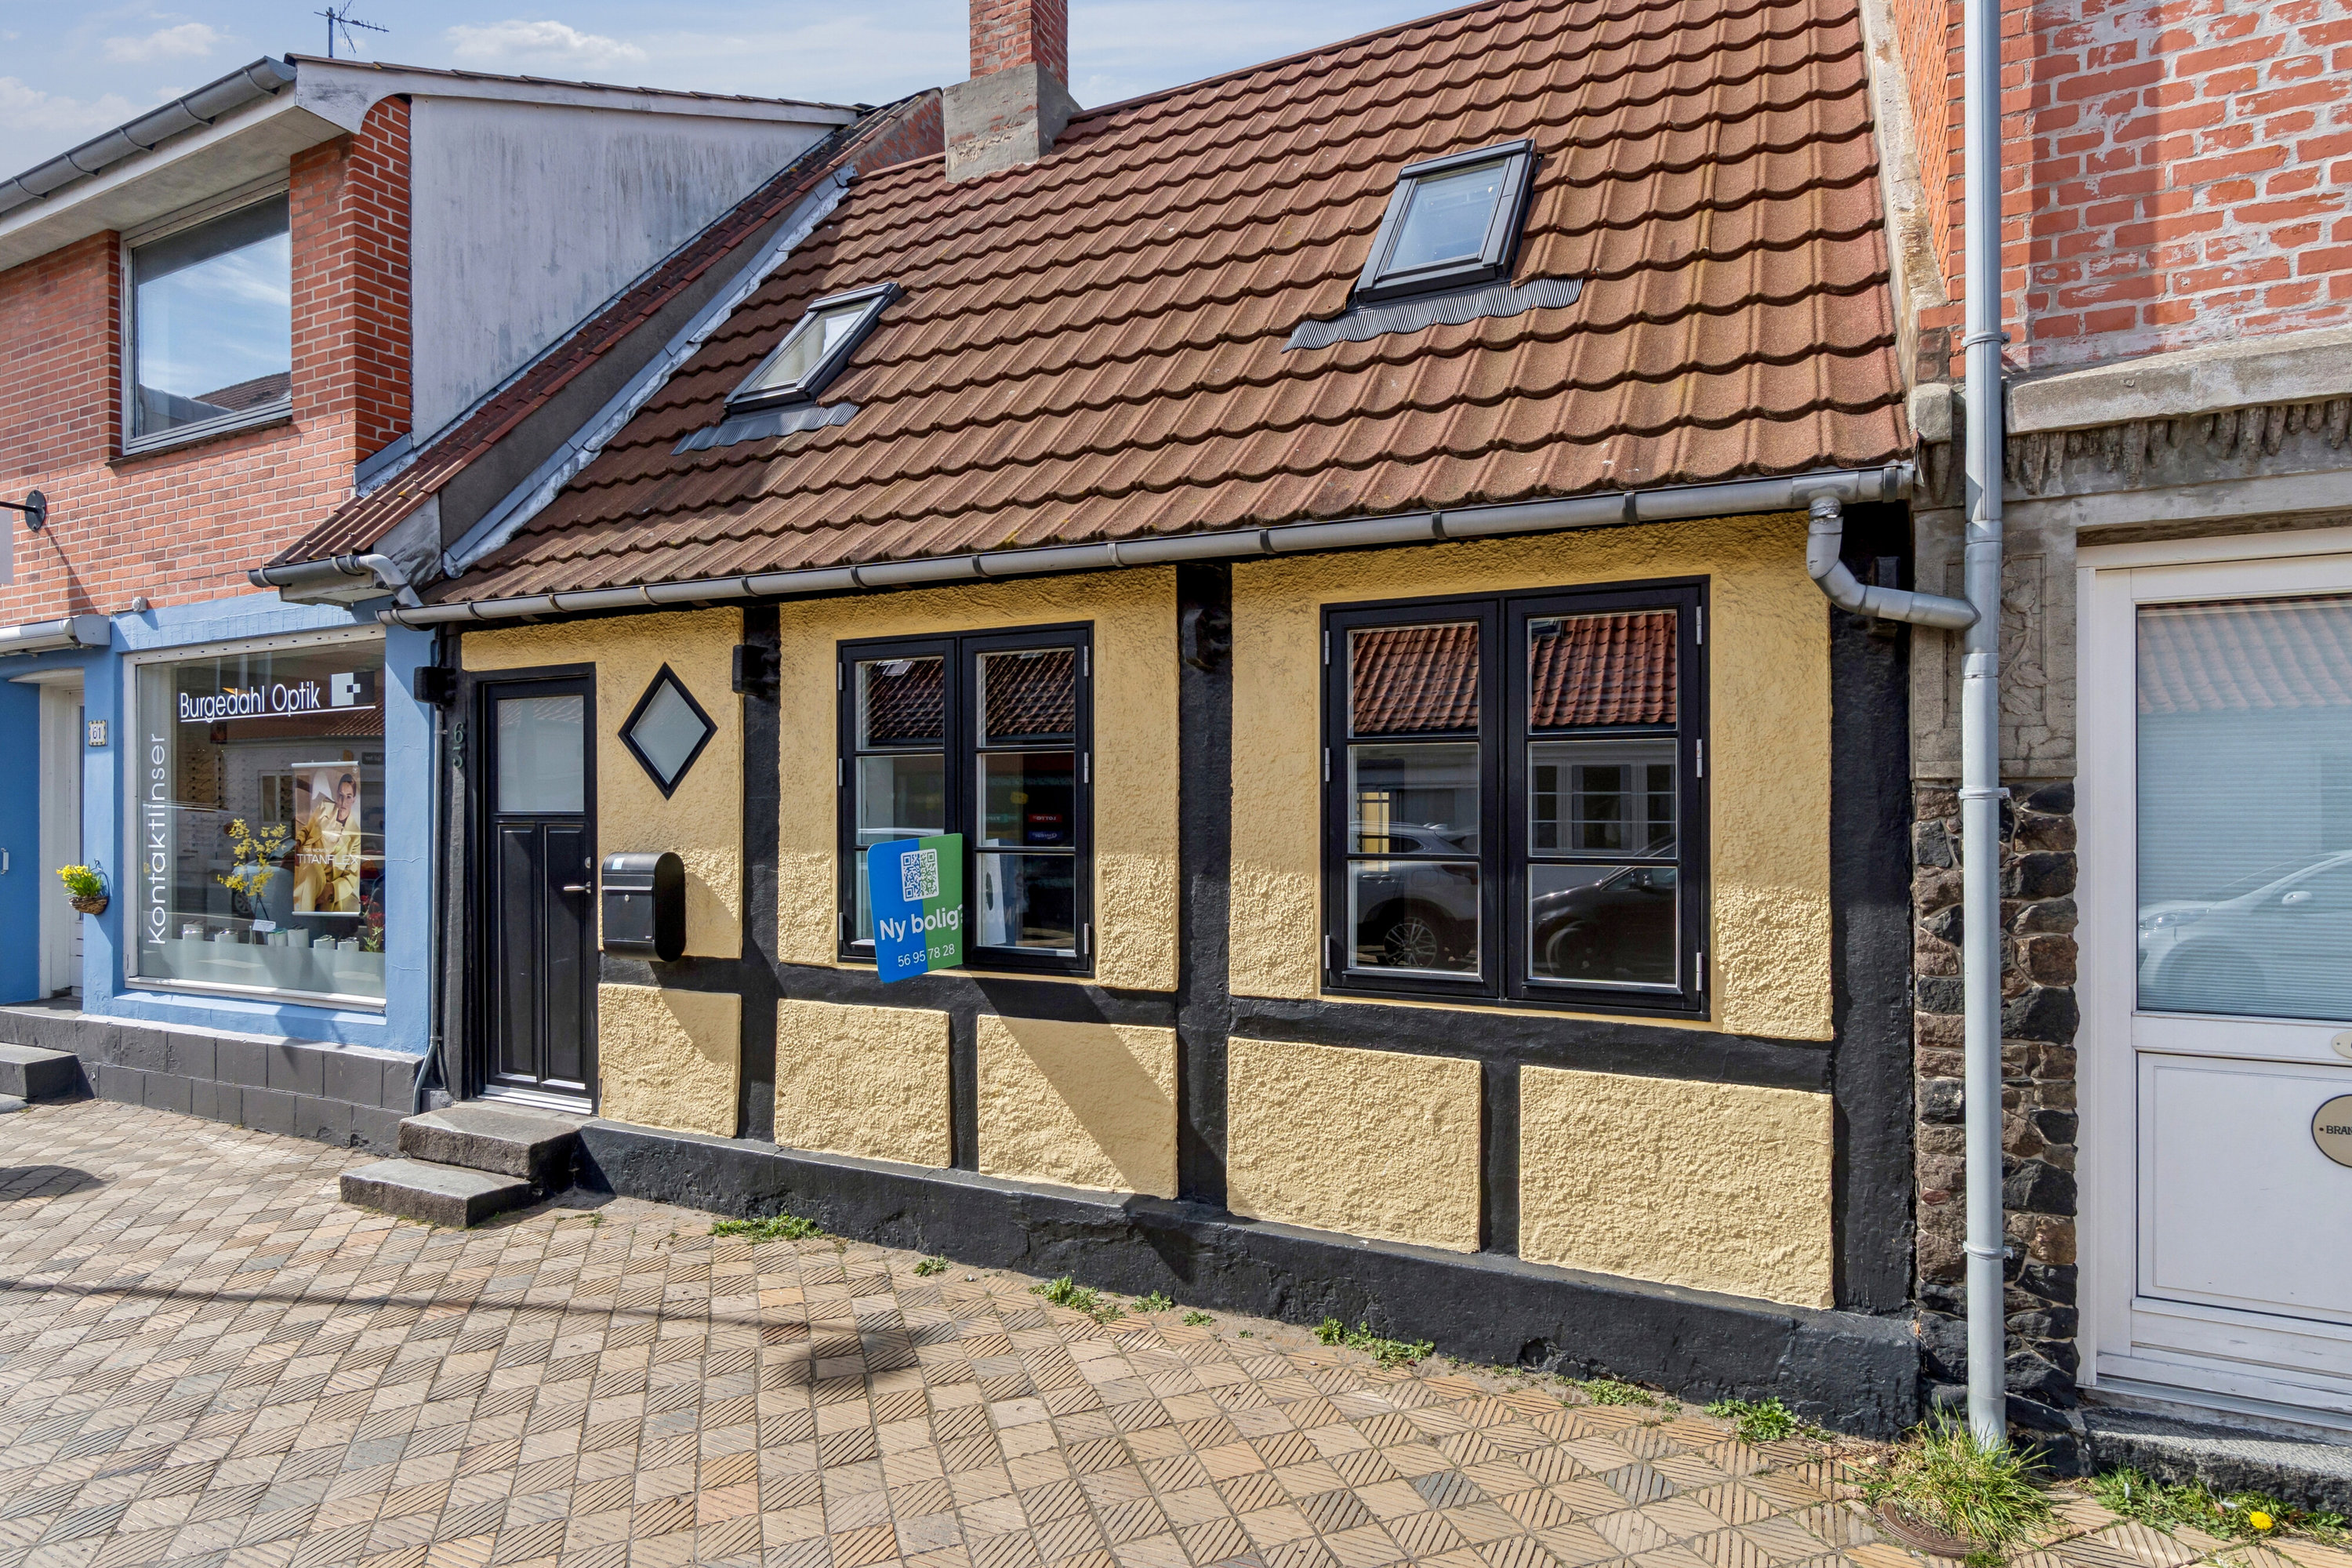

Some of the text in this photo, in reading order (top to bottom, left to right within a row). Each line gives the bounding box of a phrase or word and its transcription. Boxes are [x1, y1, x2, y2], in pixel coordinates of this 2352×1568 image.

[180, 681, 321, 723] Burgedahl Optik
[93, 726, 101, 739] 61
[148, 733, 166, 944] Kontaktlinser
[296, 854, 358, 865] TITANFLEX
[880, 917, 906, 942] Ny
[898, 943, 955, 967] 56 95 78 28
